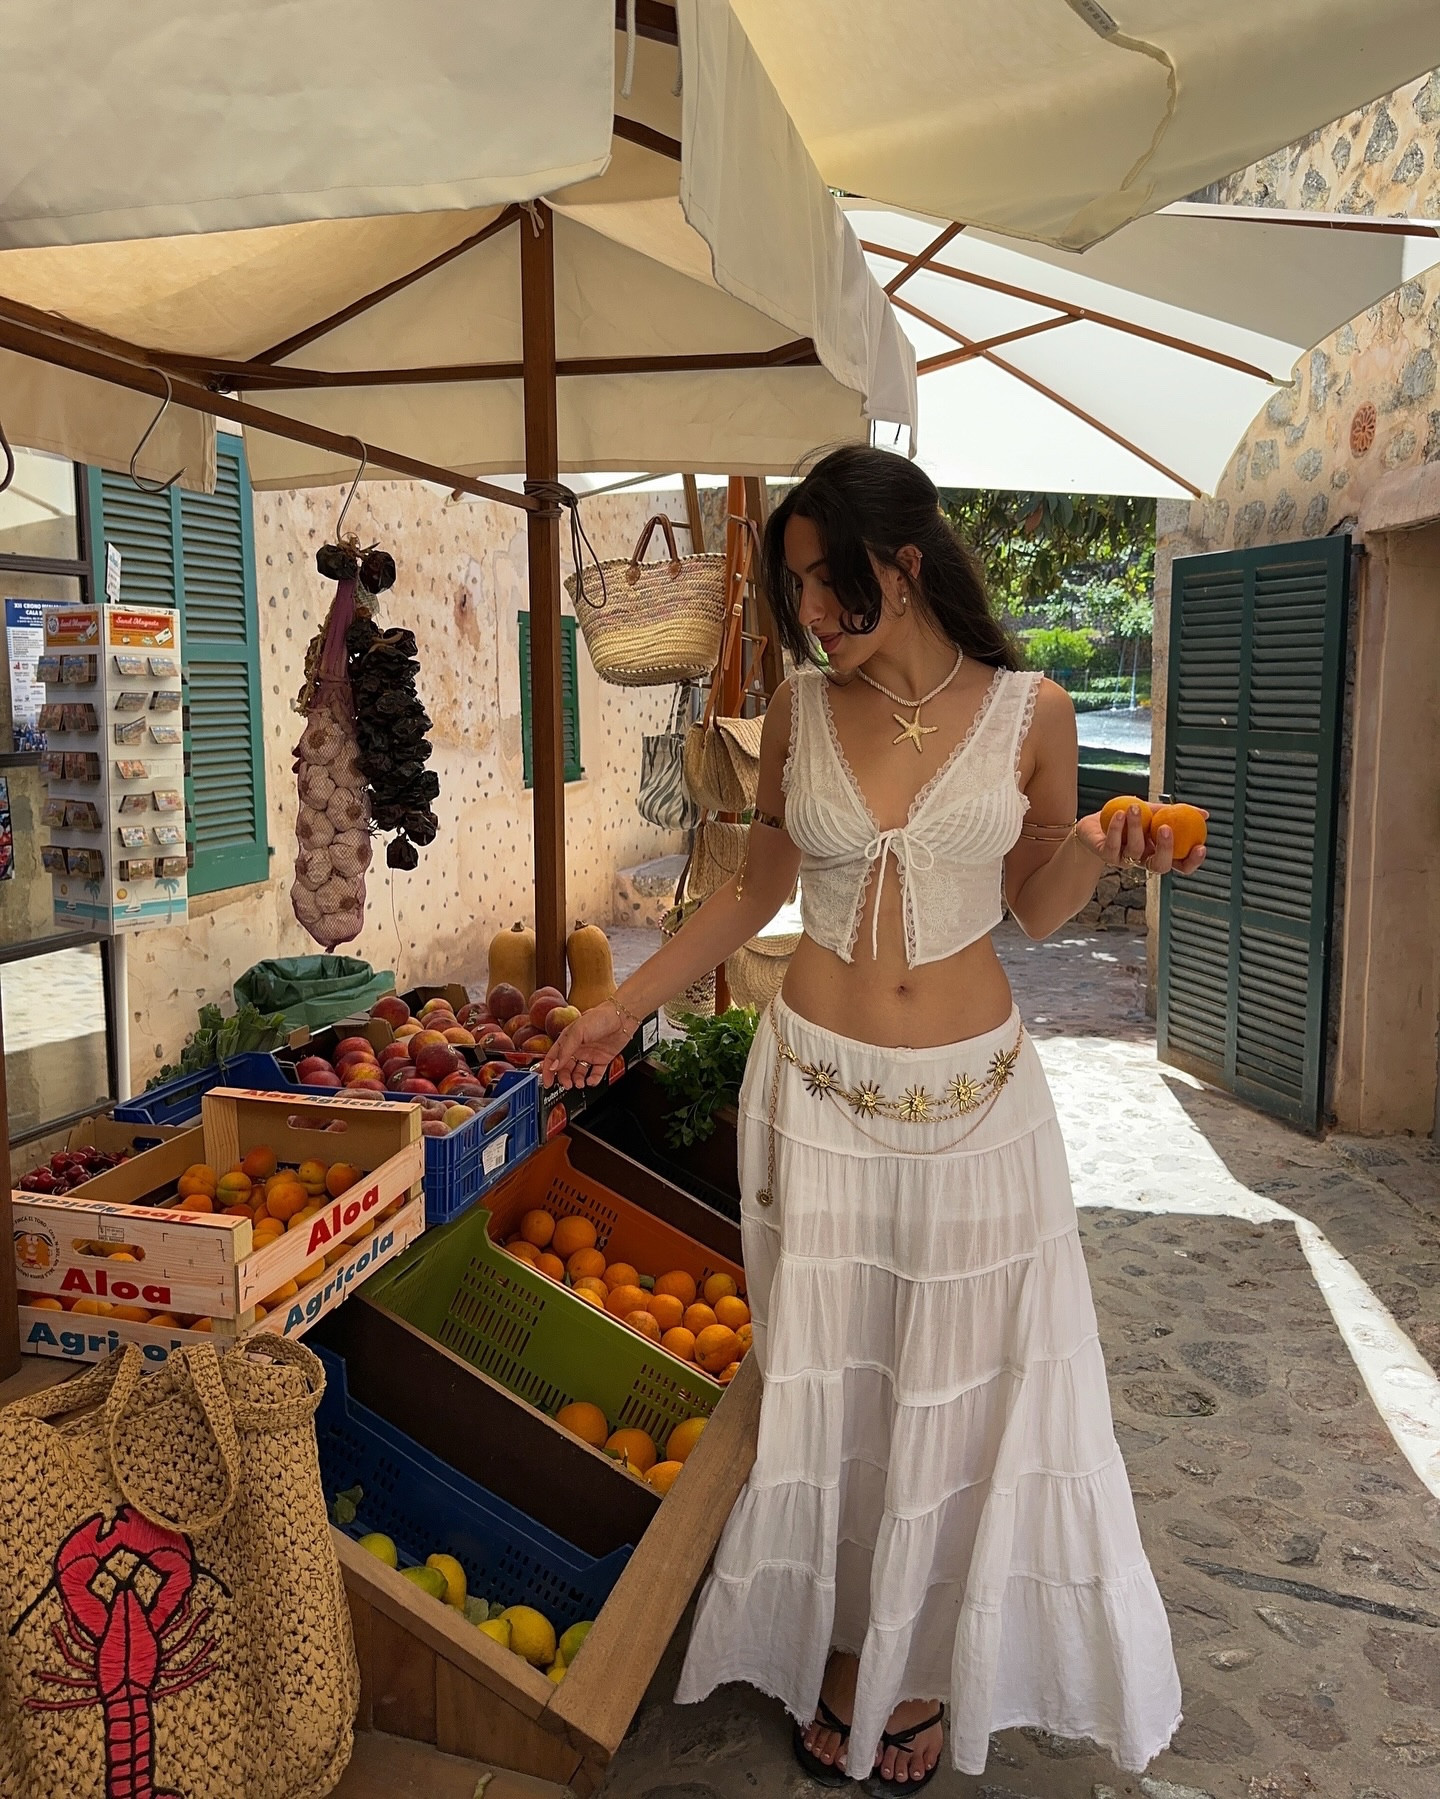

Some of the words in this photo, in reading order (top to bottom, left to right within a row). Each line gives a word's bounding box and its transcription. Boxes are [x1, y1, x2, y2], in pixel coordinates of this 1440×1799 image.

[116, 616, 132, 624] Sand
[240, 1090, 297, 1100] Aloa
[302, 1095, 396, 1108] Agricola
[16, 1194, 125, 1214] Agricola
[131, 1208, 202, 1223] Aloa
[306, 1184, 379, 1257] Aloa
[60, 1268, 171, 1305] Aloa
[282, 1230, 394, 1337] Agricola
[27, 1321, 182, 1361] Agrio
